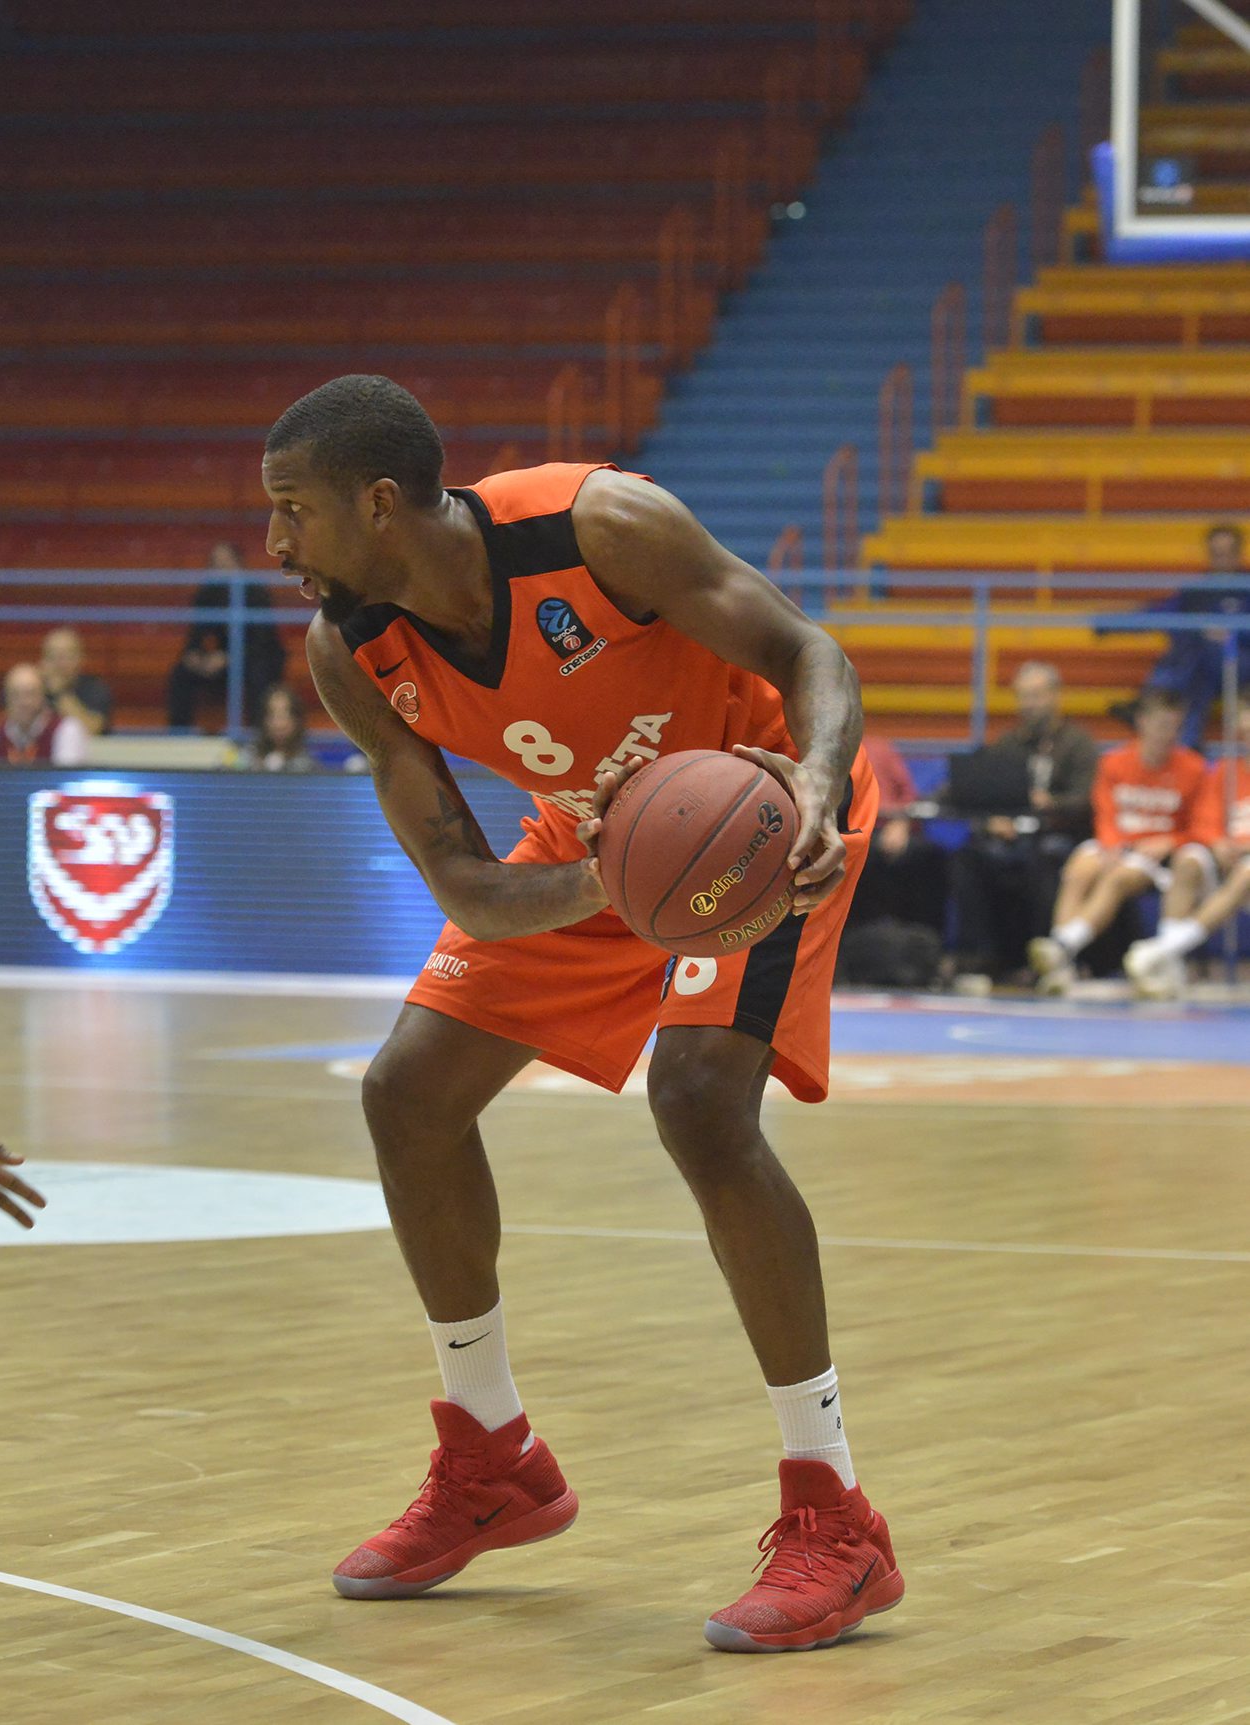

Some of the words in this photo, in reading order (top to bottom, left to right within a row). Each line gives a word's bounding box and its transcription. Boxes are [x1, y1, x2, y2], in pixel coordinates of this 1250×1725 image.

[552, 624, 578, 643] EuroCup
[559, 637, 608, 676] oneteam
[502, 719, 575, 777] 8
[710, 829, 771, 898] EuroCup
